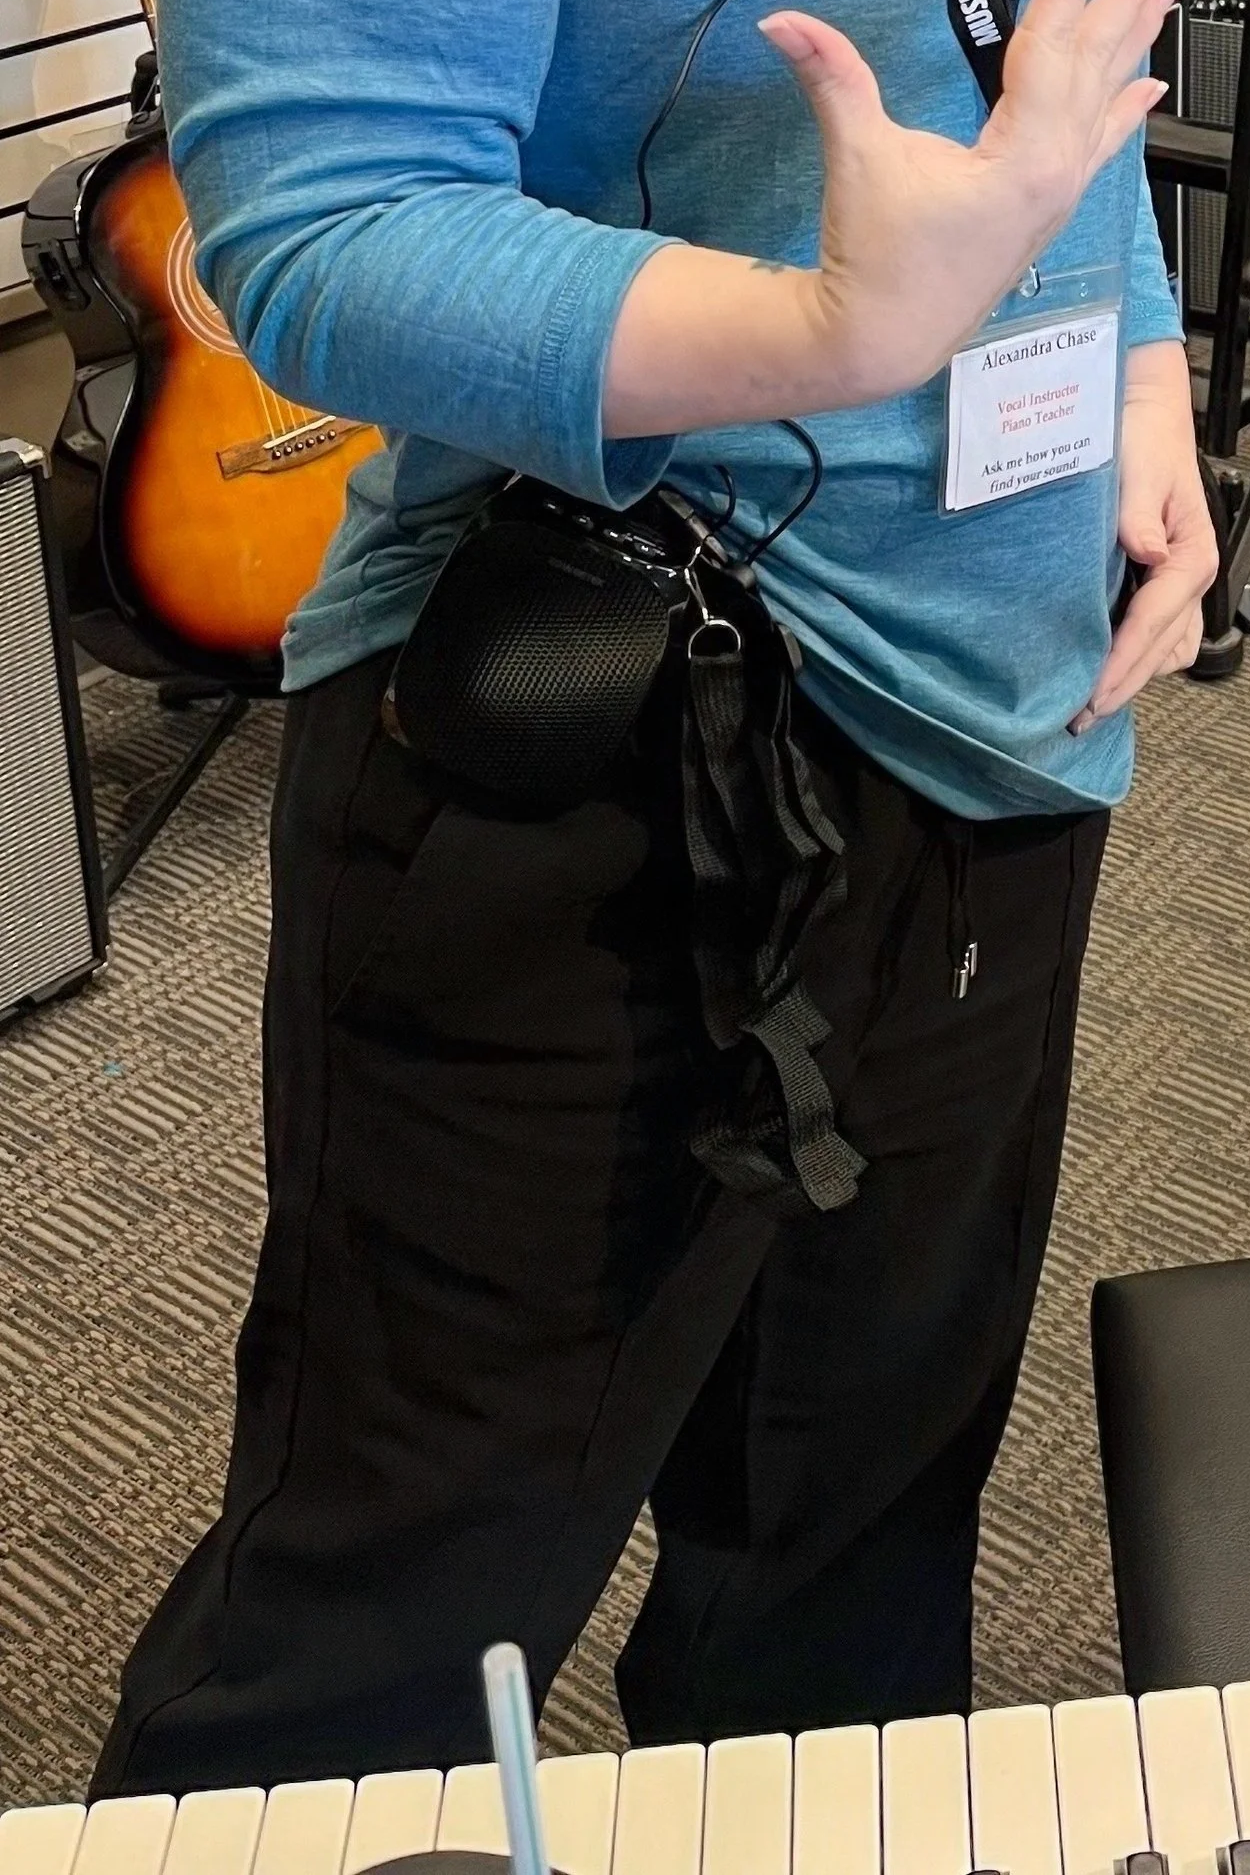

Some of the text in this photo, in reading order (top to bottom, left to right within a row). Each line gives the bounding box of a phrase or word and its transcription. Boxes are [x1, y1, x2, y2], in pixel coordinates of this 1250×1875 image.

[982, 329, 1097, 371] Alexandra Chase
[997, 383, 1080, 414] Vocal Instructor
[1001, 404, 1076, 435] Piano Teacher
[981, 437, 1091, 478] Ask me how you can
[989, 456, 1080, 494] find your sound!
